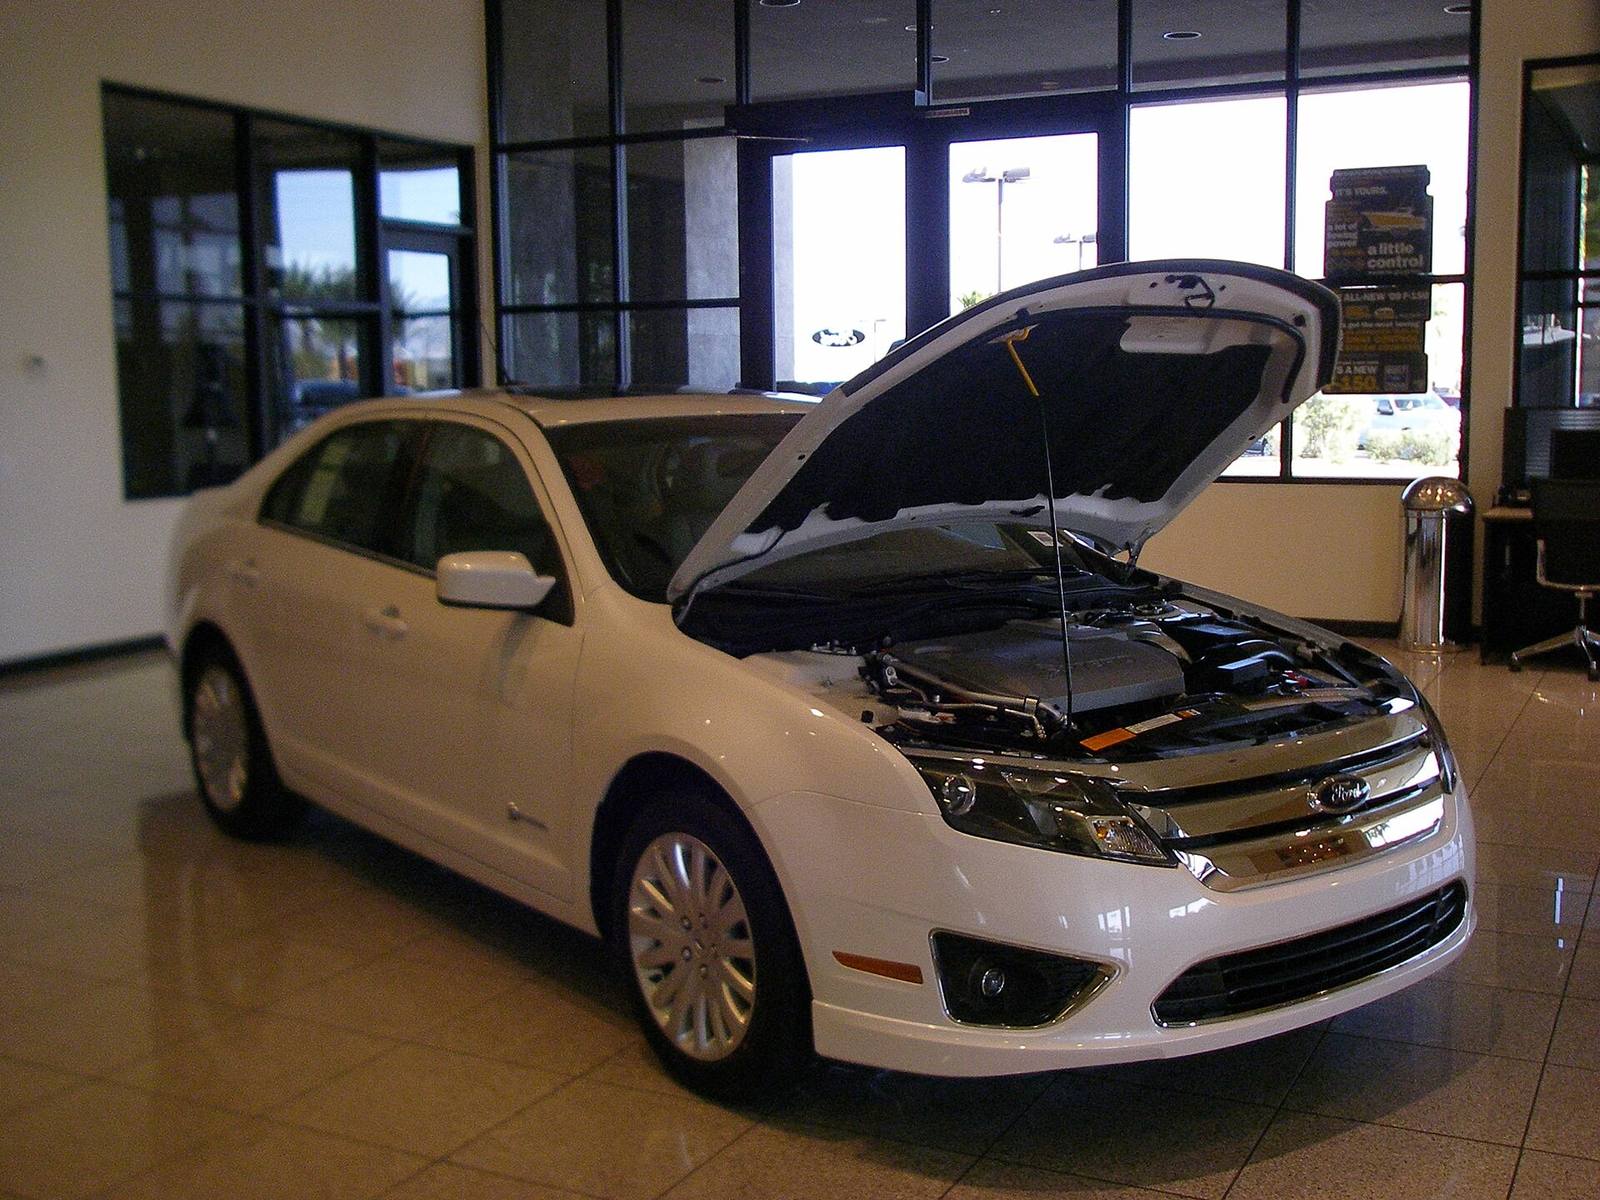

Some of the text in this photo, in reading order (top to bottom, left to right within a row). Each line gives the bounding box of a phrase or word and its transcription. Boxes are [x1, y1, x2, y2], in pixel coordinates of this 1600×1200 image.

[1367, 245, 1377, 255] a
[1379, 242, 1415, 255] little
[1367, 254, 1424, 269] control
